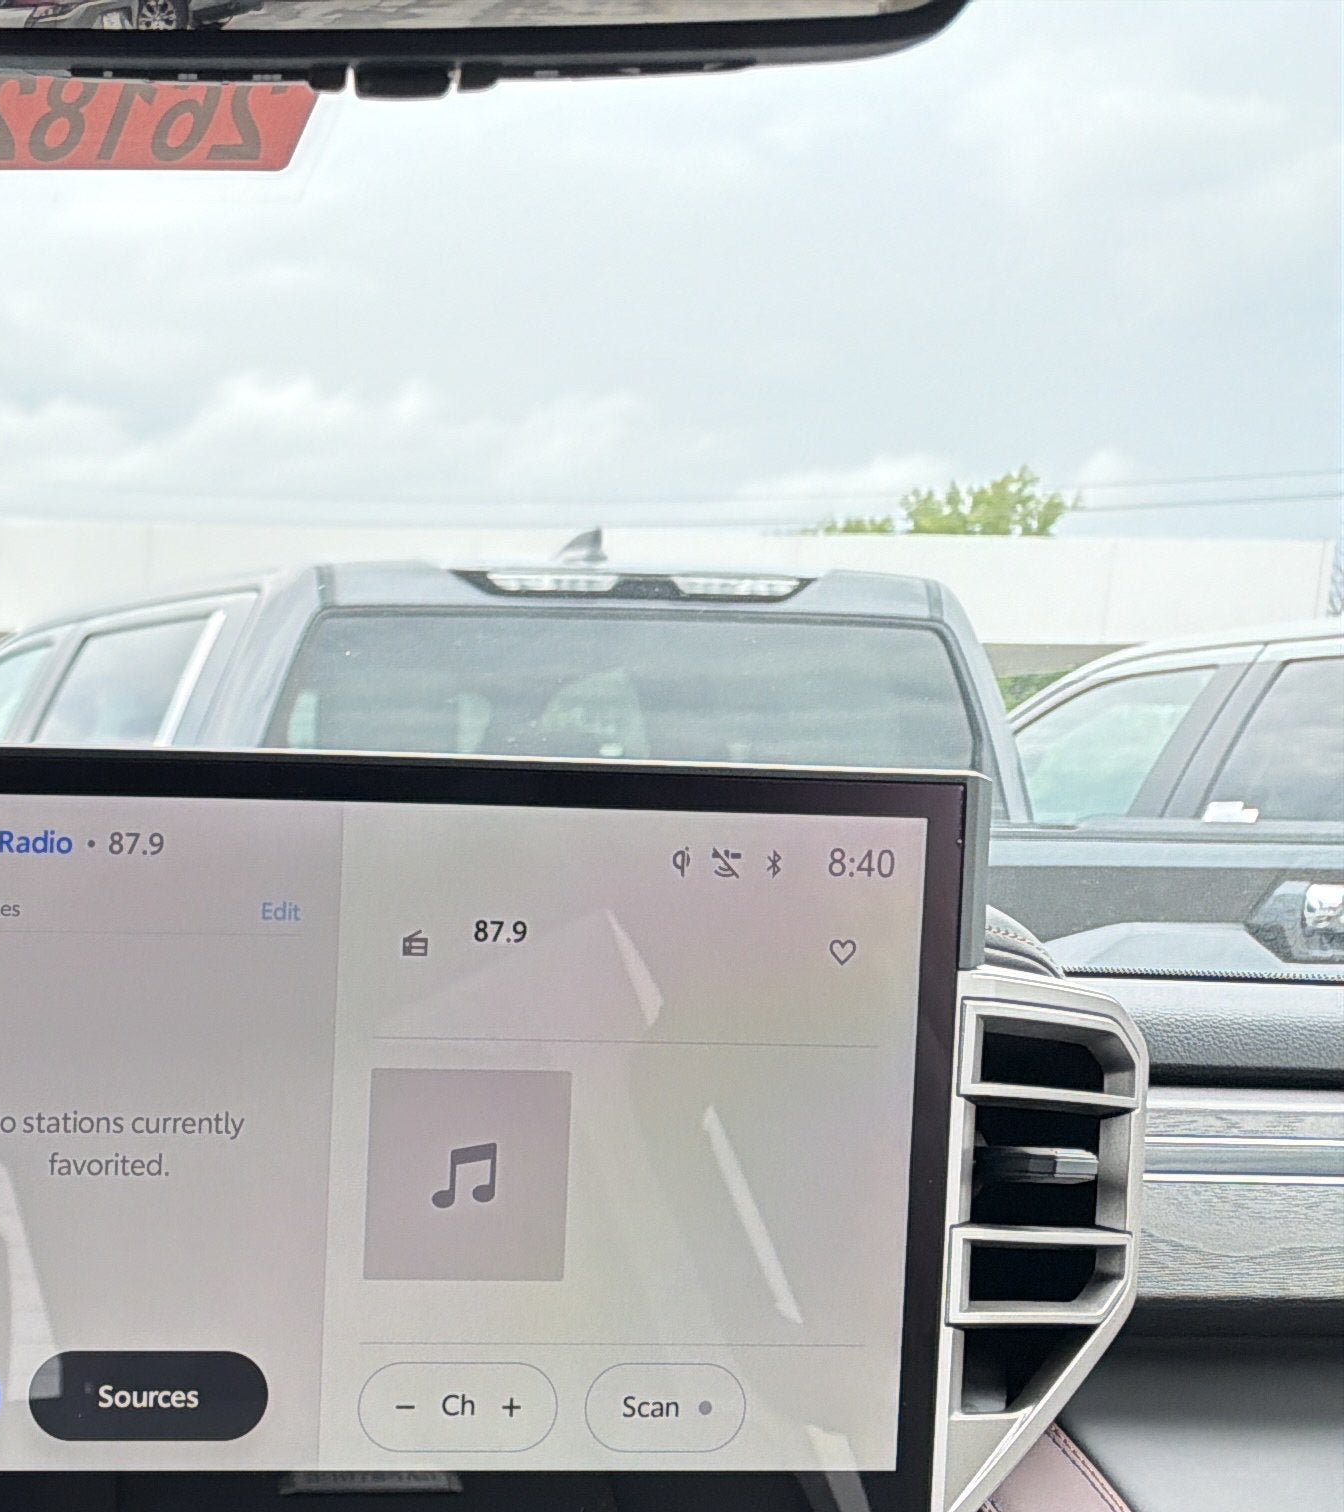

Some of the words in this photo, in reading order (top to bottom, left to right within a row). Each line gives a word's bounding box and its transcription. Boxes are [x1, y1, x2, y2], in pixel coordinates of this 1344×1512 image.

[108, 831, 164, 855] 87.9
[828, 848, 895, 879] 8:40
[260, 901, 301, 922] Edit
[473, 920, 528, 944] 87.9
[22, 1110, 124, 1135] stations
[131, 1110, 244, 1140] currently
[48, 1152, 170, 1177] favorited.
[98, 1384, 199, 1409] Sources
[441, 1394, 476, 1417] Ch
[622, 1395, 680, 1418] Scan
